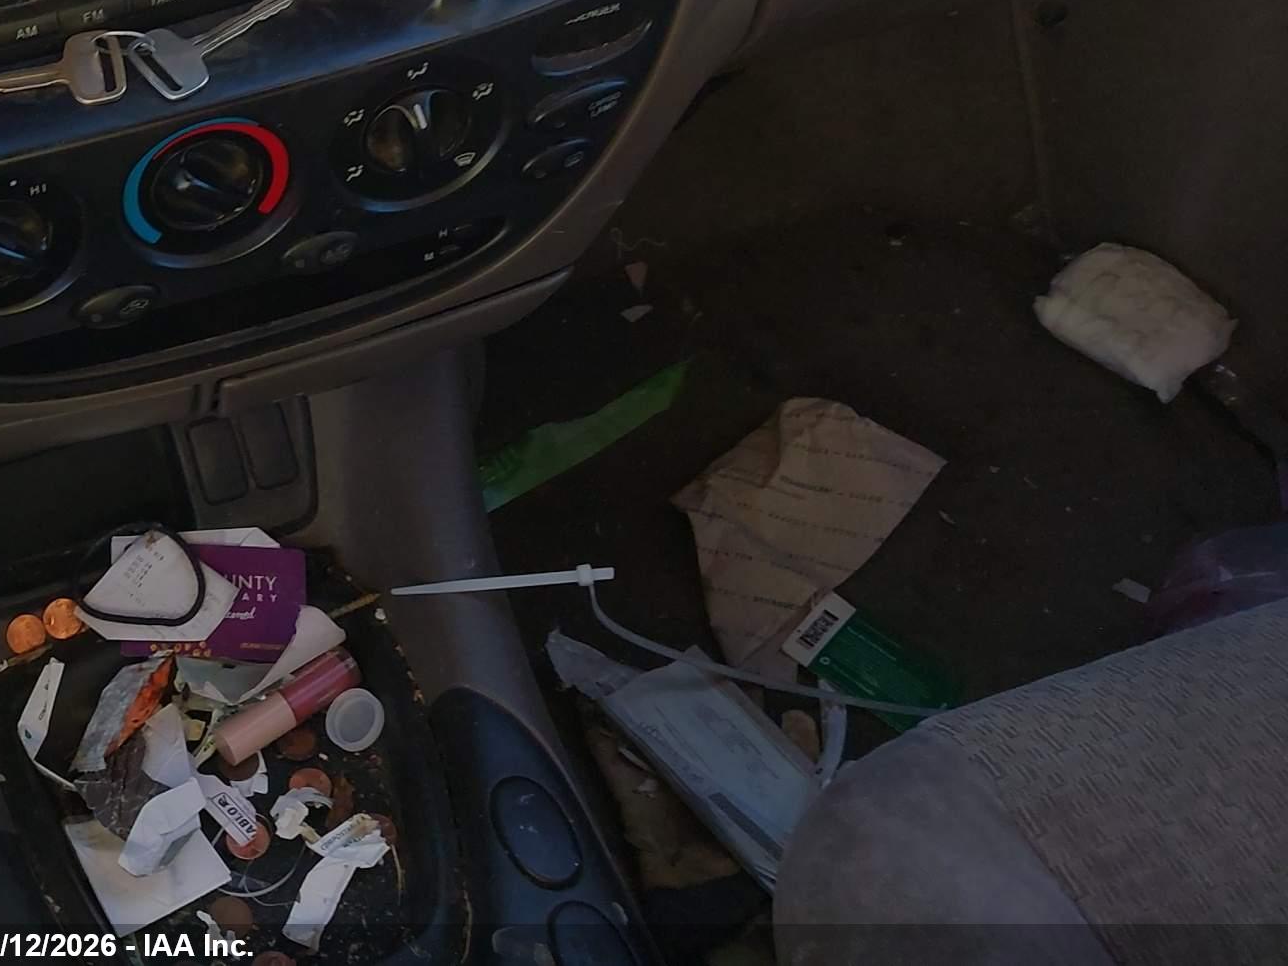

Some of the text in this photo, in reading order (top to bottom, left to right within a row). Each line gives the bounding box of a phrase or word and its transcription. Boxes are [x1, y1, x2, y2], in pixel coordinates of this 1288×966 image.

[81, 8, 105, 24] FM
[15, 24, 40, 42] AM
[29, 183, 48, 197] HI
